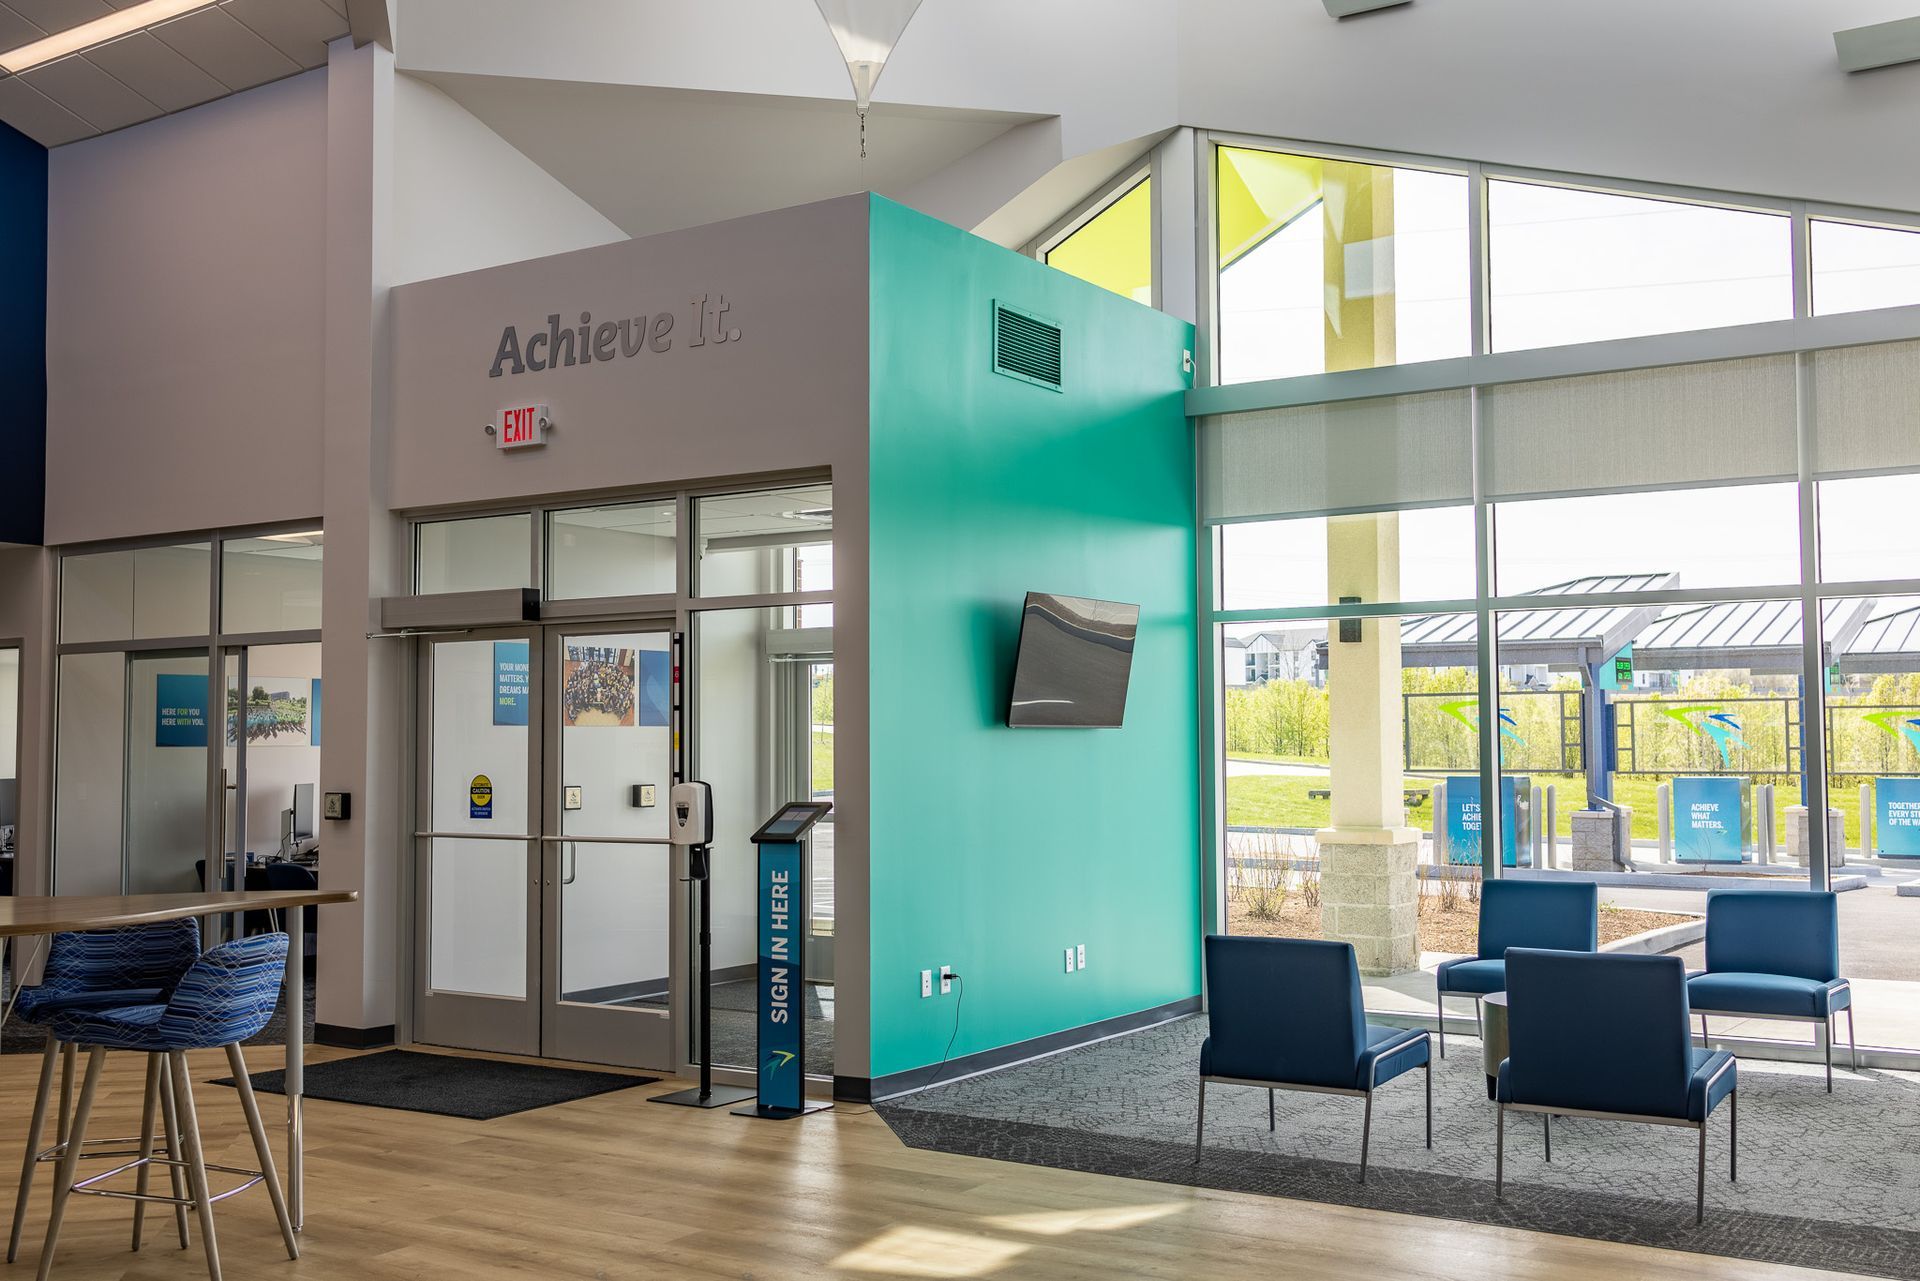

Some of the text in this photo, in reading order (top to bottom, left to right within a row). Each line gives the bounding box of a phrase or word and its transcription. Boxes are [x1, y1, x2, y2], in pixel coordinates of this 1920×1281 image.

[489, 293, 742, 378] Achieve It.
[504, 407, 535, 443] EXIT
[499, 662, 529, 672] YOUR MONE
[499, 685, 521, 695] DREAMS
[499, 697, 516, 706] MORE.
[161, 708, 200, 716] HERE FOR YOU
[161, 718, 176, 726] HERE
[177, 718, 191, 726] WITH
[1462, 803, 1481, 812] LET'S
[1691, 803, 1719, 812] ACHIEVE
[1462, 812, 1482, 821] ACHIE
[1691, 812, 1710, 820] WHAT
[1888, 810, 1909, 818] EVERY
[1462, 822, 1482, 830] TOGET
[1692, 821, 1724, 829] MATTERS.
[1889, 818, 1897, 826] OF
[1898, 818, 1911, 826] THE
[771, 870, 788, 1024] SIGN IN HERE
